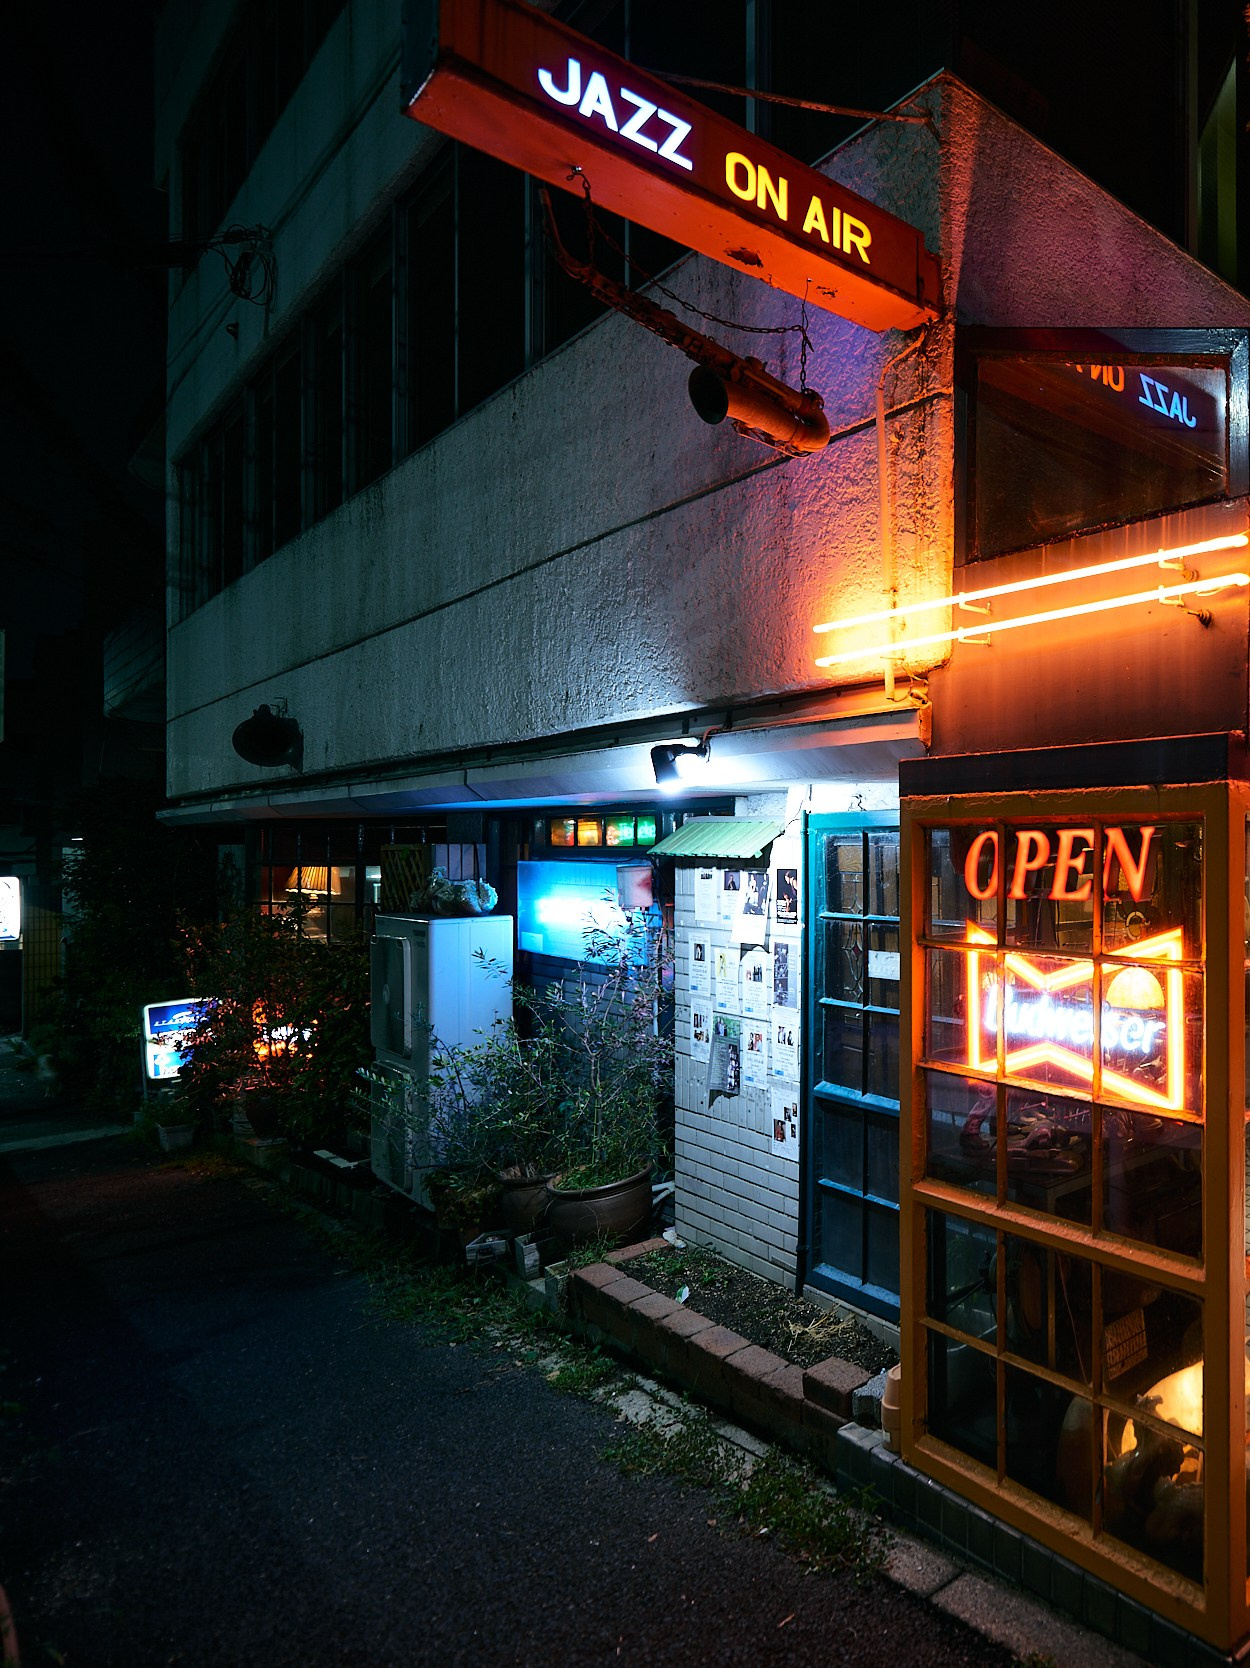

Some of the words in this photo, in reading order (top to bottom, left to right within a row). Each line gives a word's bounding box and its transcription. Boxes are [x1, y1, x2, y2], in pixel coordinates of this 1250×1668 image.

[537, 57, 693, 171] JAZZ
[725, 151, 789, 222] ON
[802, 195, 872, 265] AIR
[964, 826, 1156, 903] OPEN
[984, 982, 1167, 1054] Budweser
